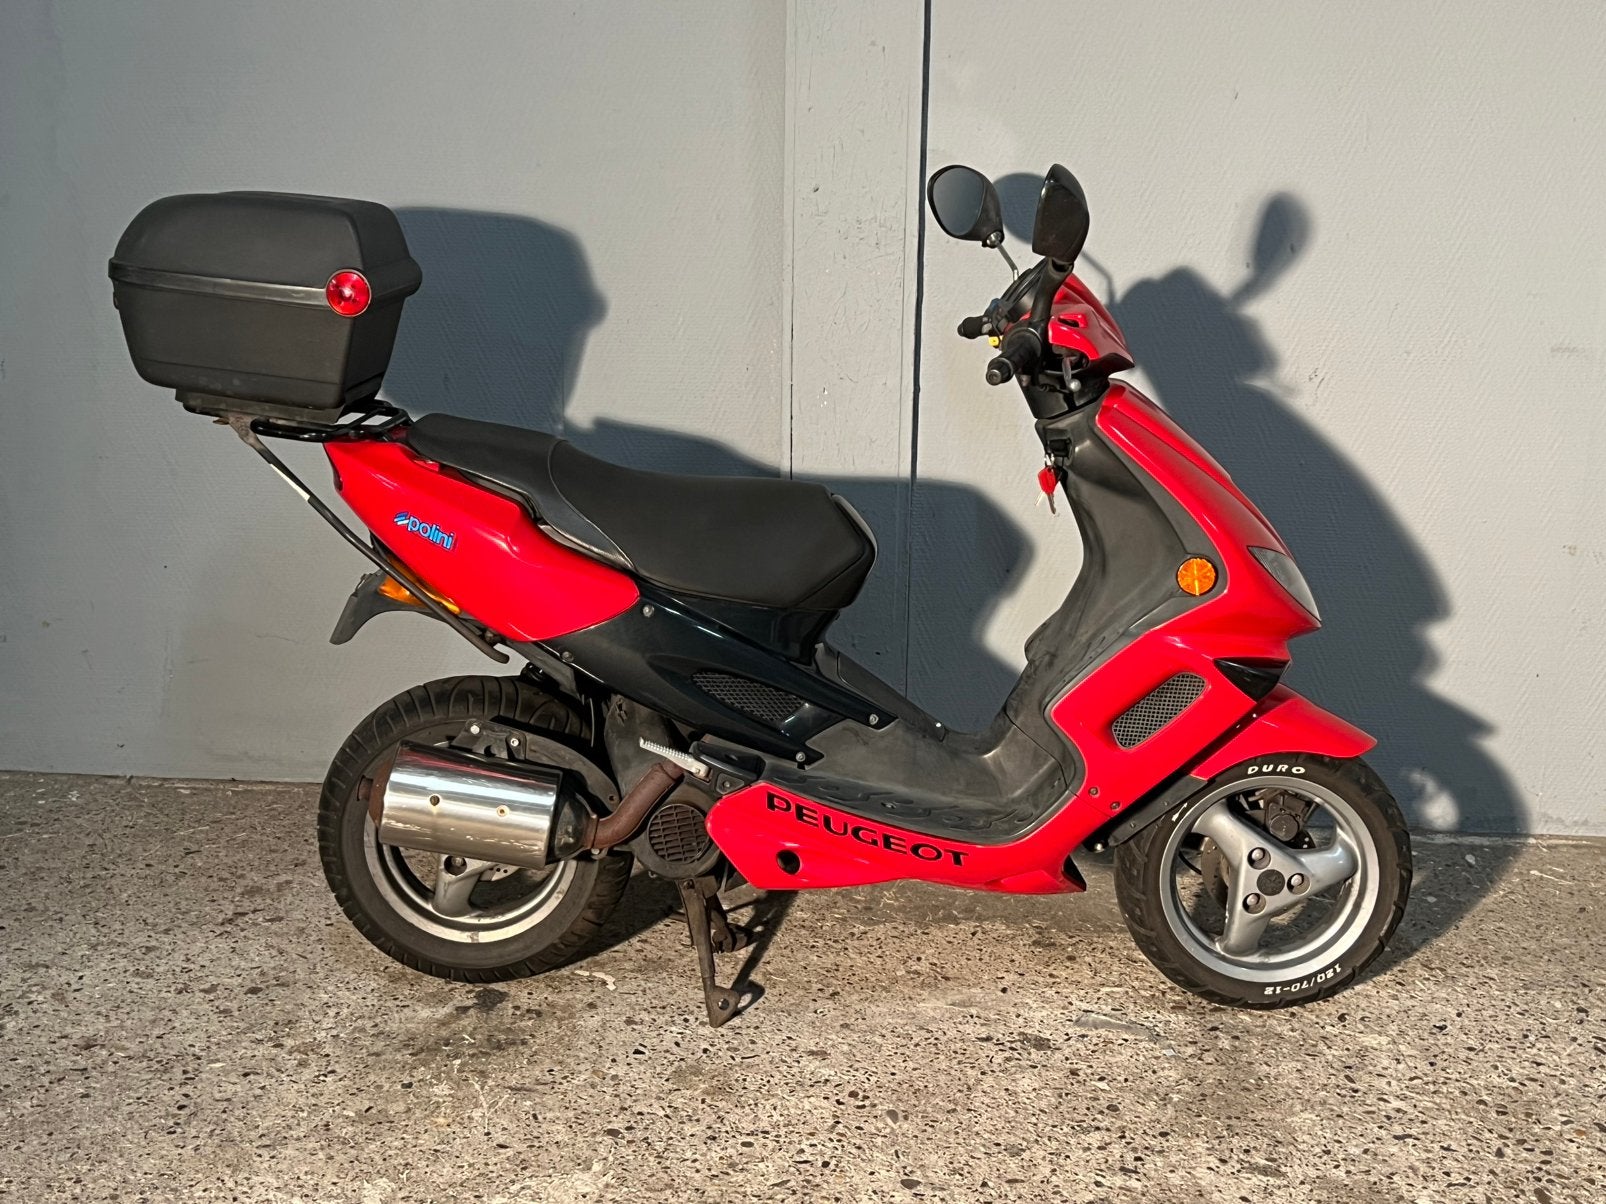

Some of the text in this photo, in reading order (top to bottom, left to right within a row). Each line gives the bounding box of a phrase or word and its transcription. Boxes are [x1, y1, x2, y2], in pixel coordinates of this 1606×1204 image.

[407, 515, 454, 550] polini
[1247, 764, 1306, 775] DURO
[766, 791, 969, 867] PEUGEOT
[1263, 963, 1342, 995] 120/70-12
